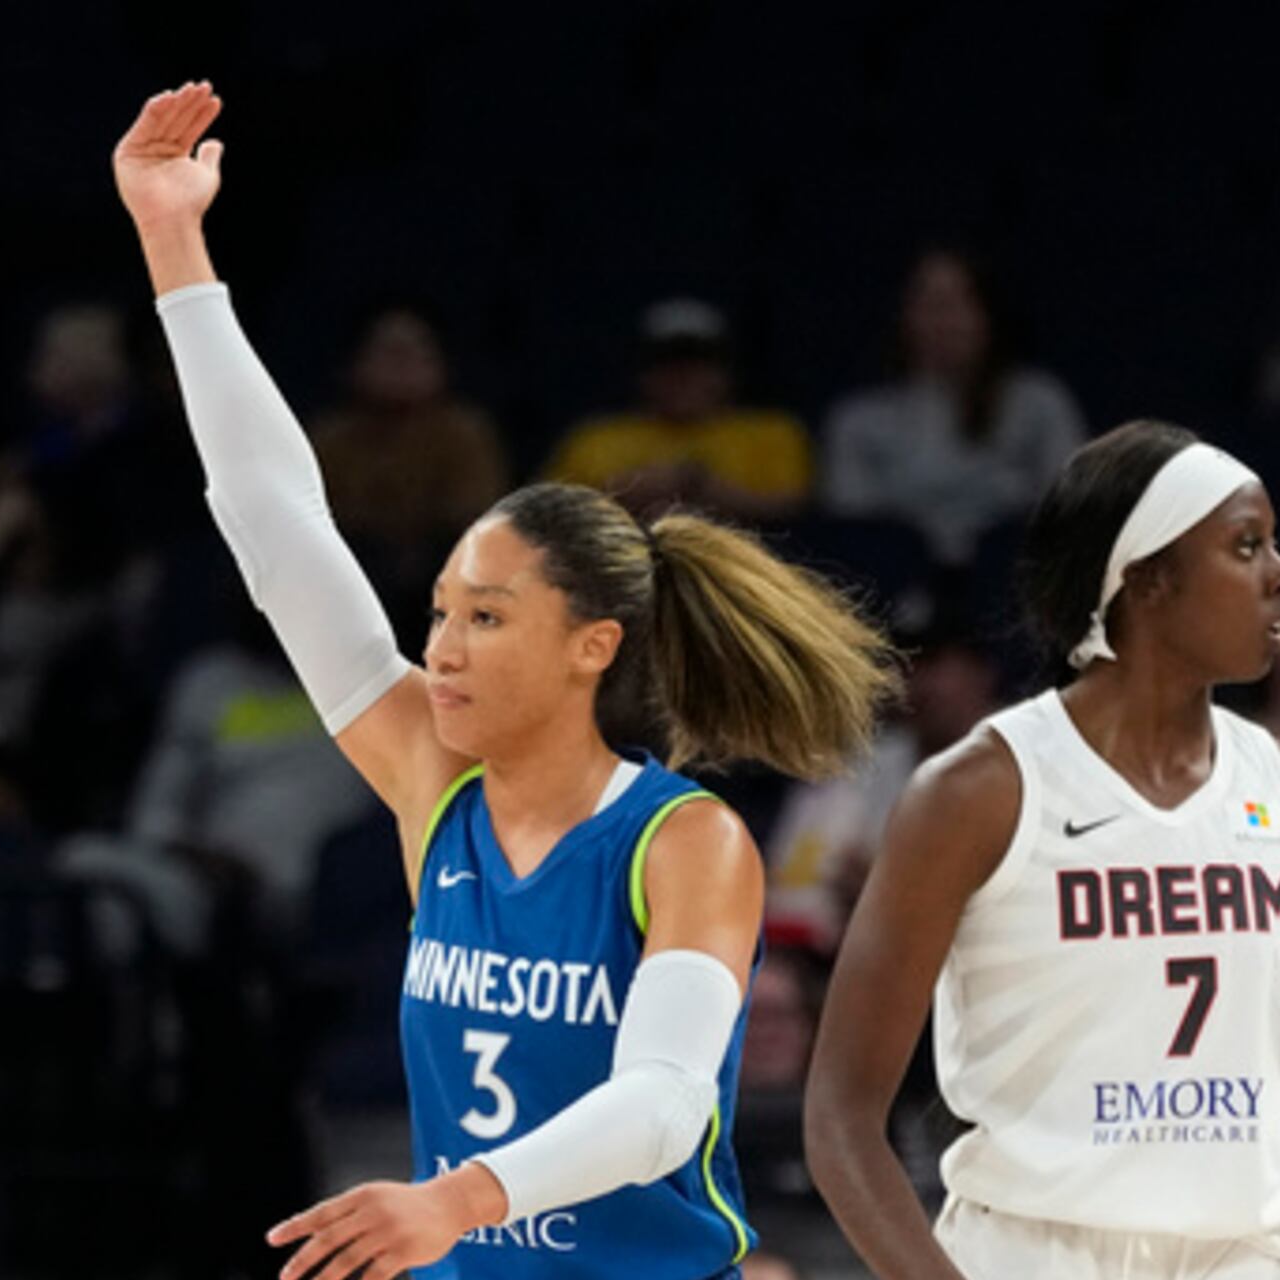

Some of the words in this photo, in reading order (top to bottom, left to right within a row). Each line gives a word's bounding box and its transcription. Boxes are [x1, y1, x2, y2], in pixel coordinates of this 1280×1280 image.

[403, 936, 618, 1026] MINNESOTA
[1166, 956, 1218, 1059] 7
[459, 1029, 517, 1139] 3
[1093, 1078, 1264, 1123] EMORY
[1093, 1126, 1259, 1145] HEALTHCARE
